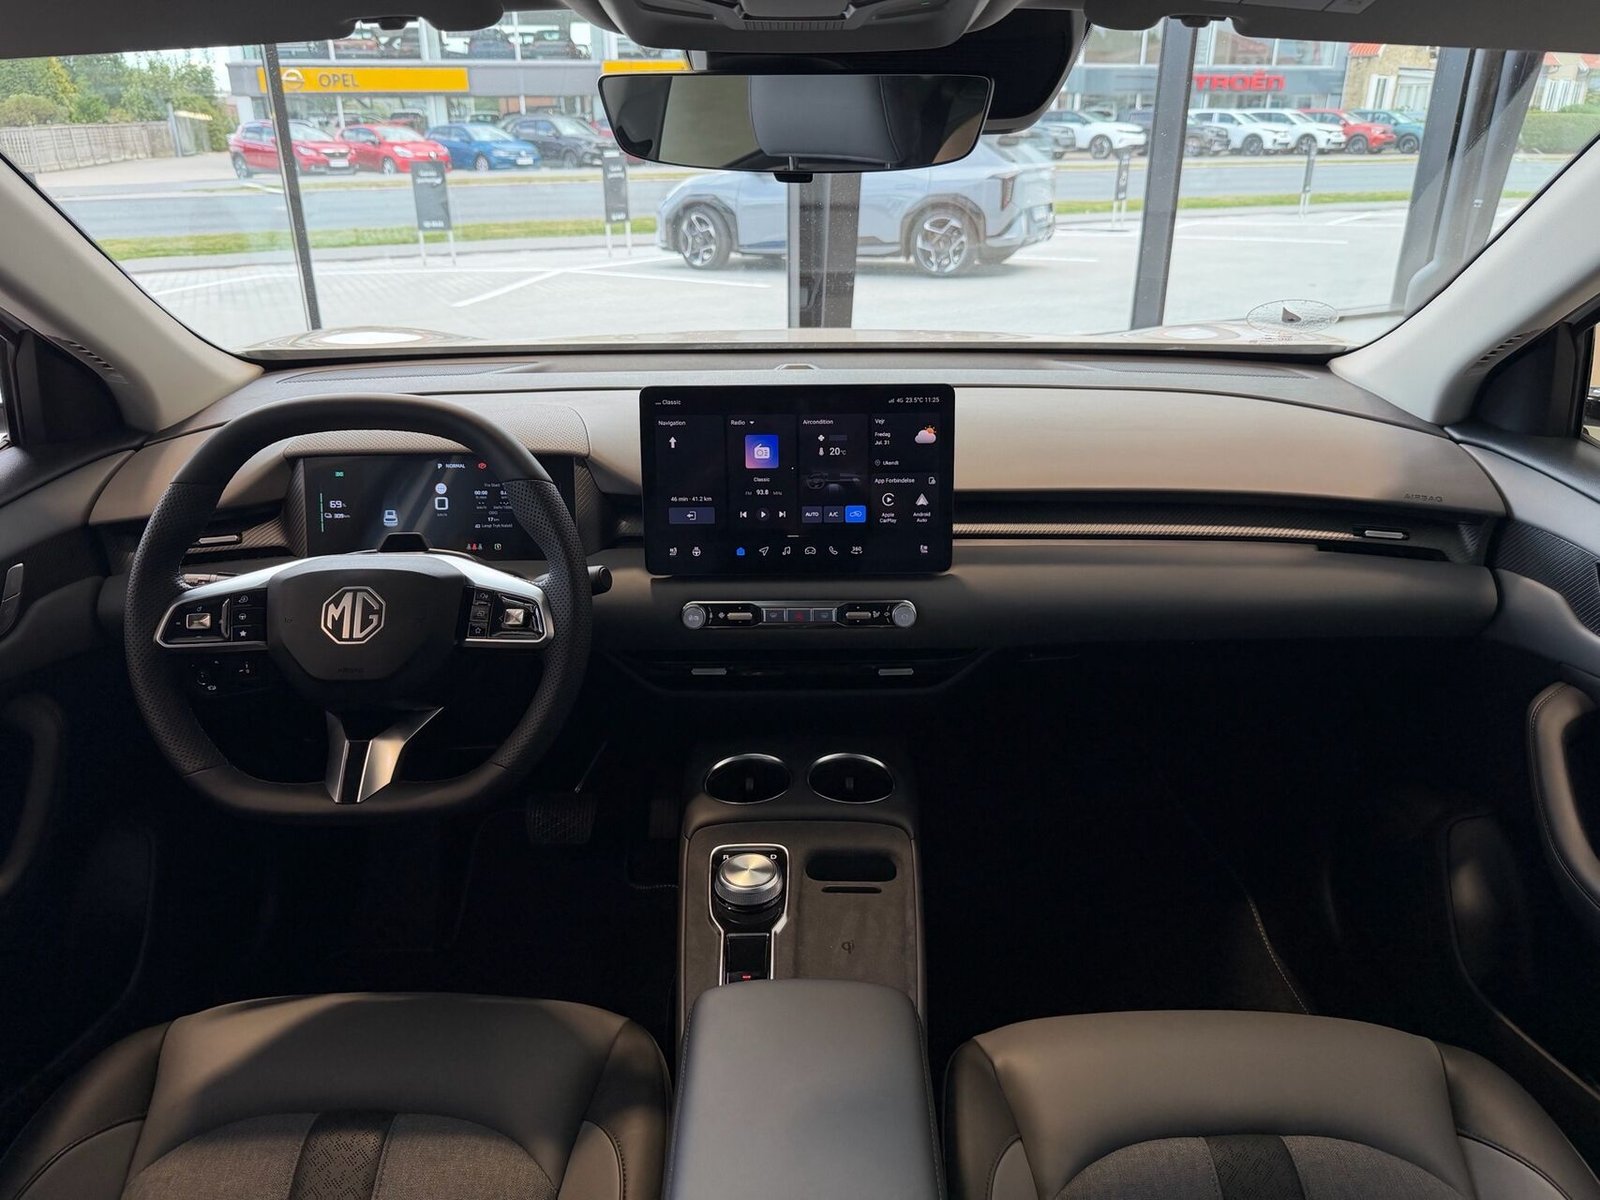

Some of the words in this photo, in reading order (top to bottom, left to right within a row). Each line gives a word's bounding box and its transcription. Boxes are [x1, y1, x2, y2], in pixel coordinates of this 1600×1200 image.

[319, 74, 360, 88] OPEL
[1193, 69, 1285, 91] TROËN
[325, 590, 382, 641] MG
